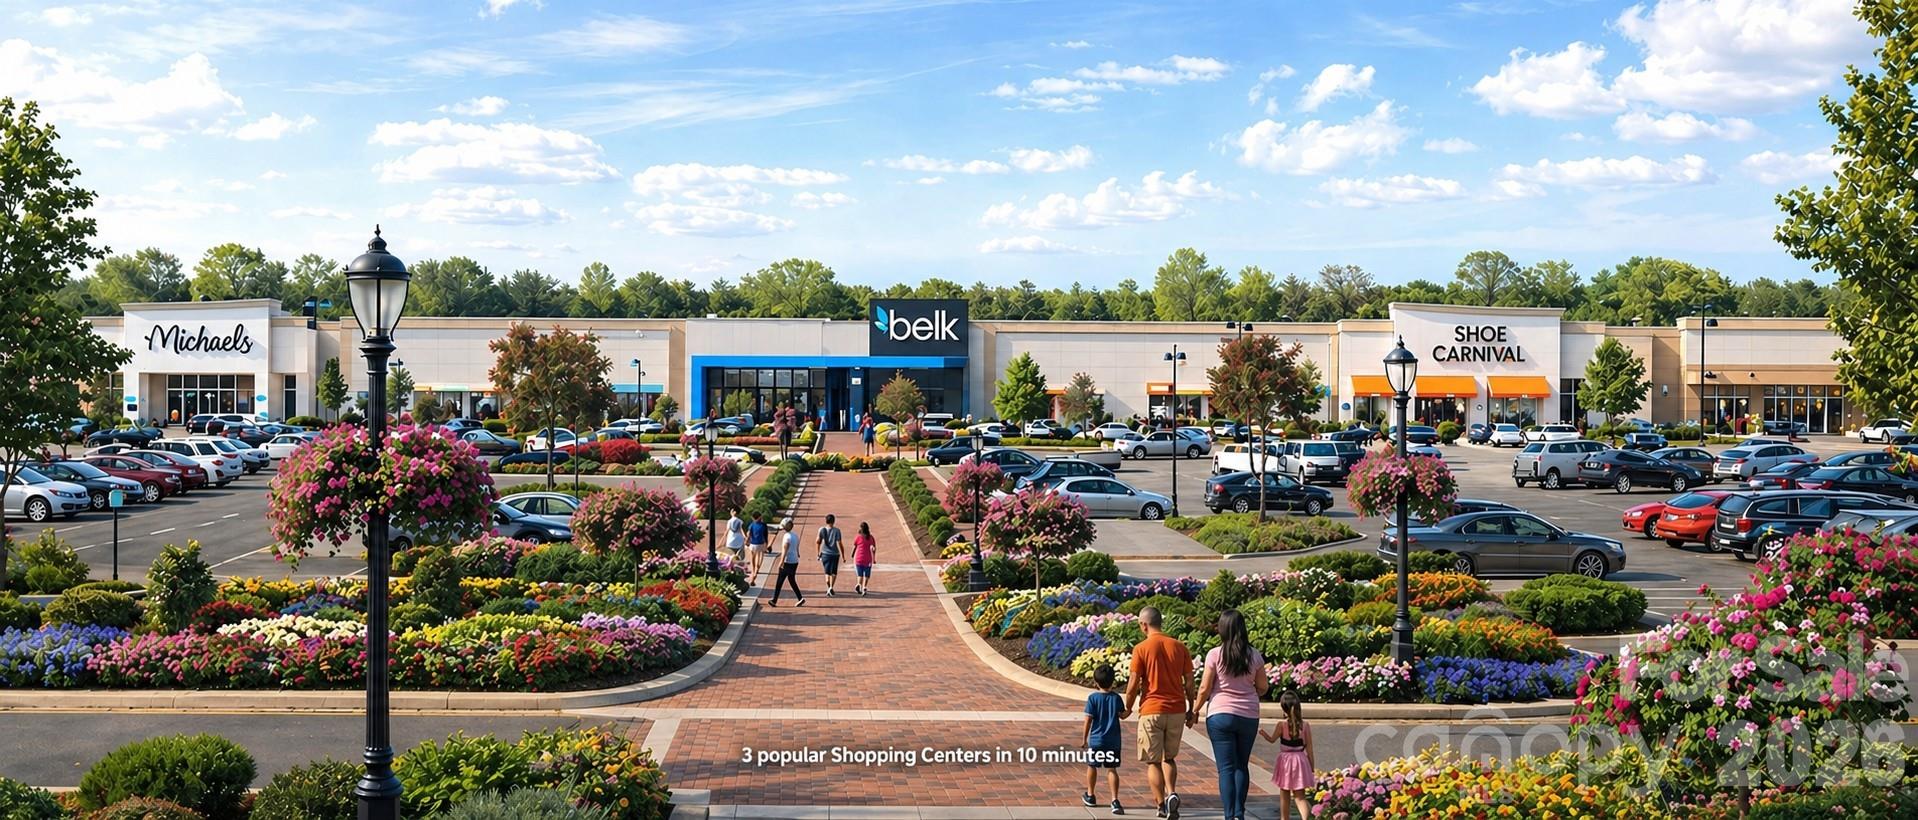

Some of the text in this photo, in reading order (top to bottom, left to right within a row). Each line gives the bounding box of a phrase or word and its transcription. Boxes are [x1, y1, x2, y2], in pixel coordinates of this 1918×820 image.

[889, 309, 960, 341] belk
[1454, 325, 1507, 342] SHOE
[144, 323, 253, 355] Michaels
[1432, 345, 1525, 362] CARNIVAL
